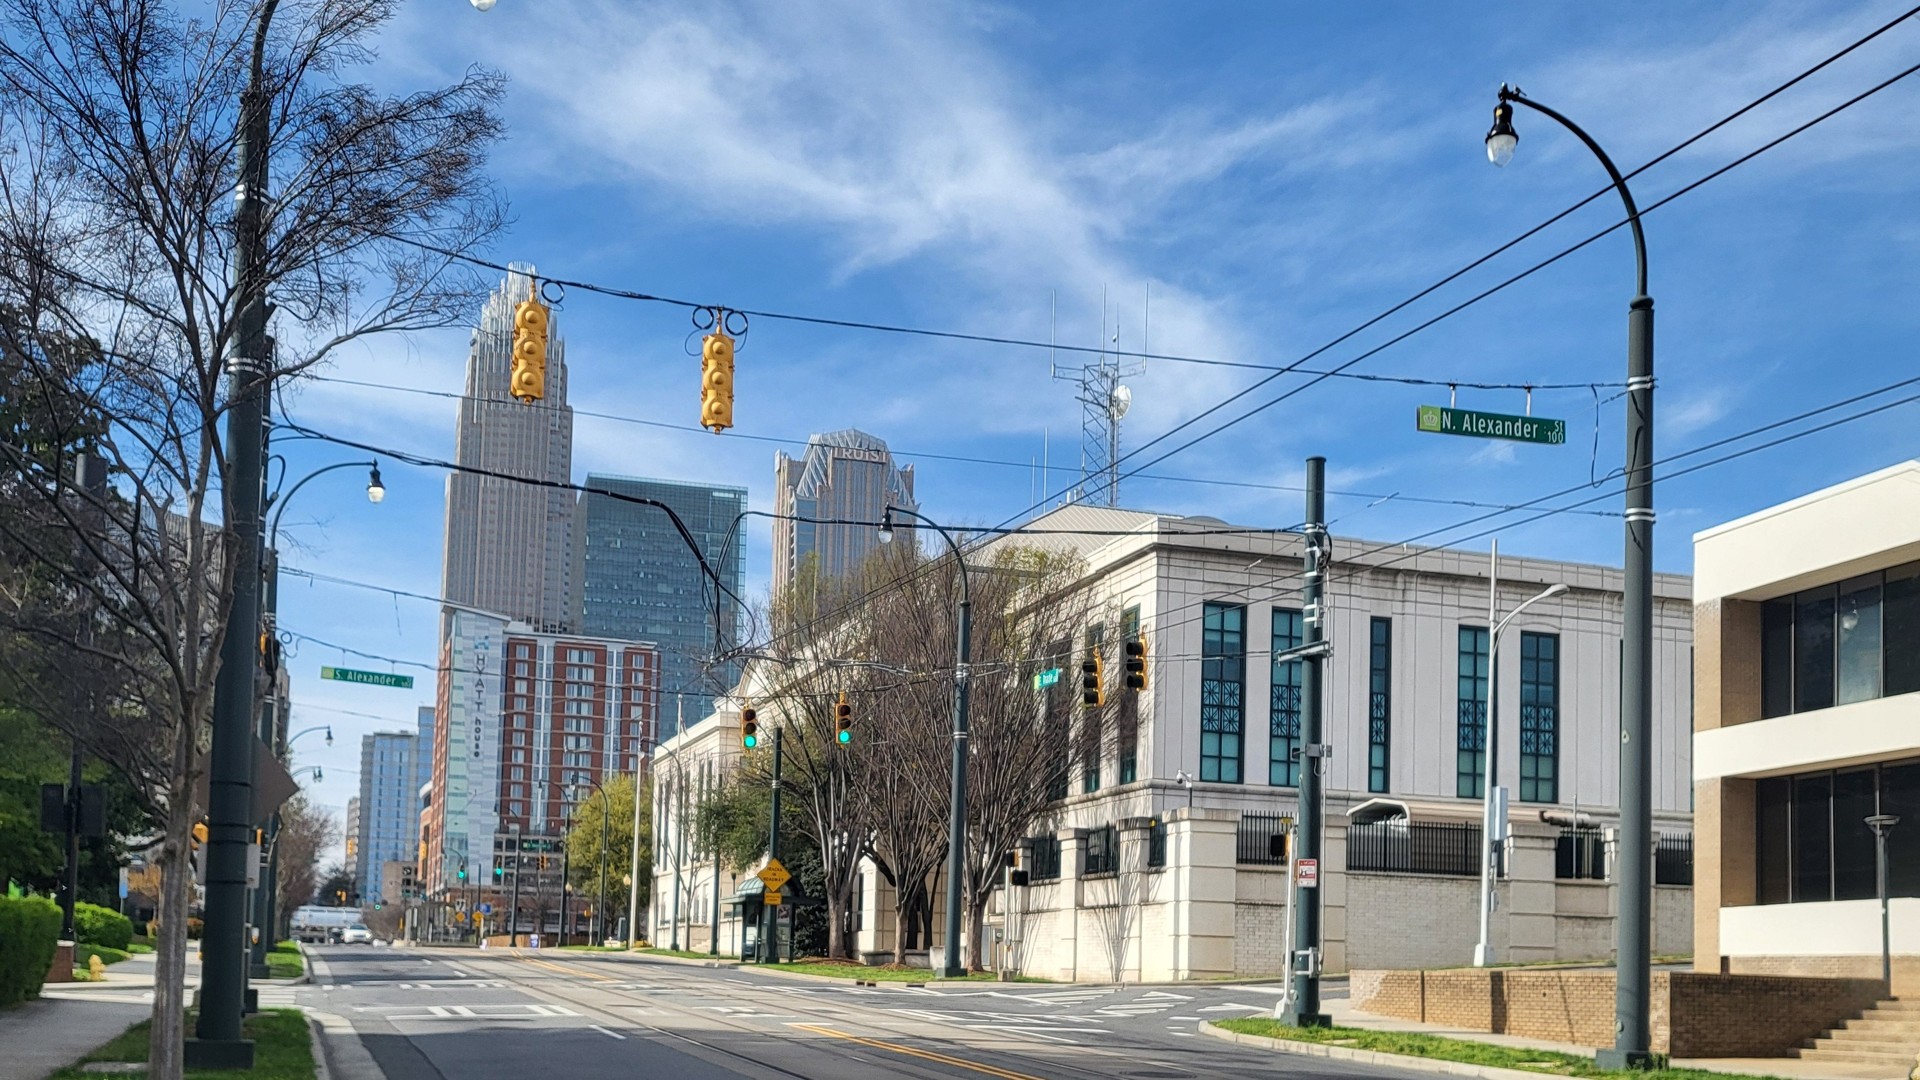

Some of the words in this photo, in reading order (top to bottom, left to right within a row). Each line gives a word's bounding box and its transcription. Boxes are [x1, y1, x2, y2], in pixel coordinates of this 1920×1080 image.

[1442, 411, 1456, 430] N.
[1462, 413, 1539, 439] Alexander
[1554, 420, 1564, 432] St
[1547, 431, 1564, 443] 100
[335, 669, 344, 680] S.
[347, 671, 396, 686] Alexander
[474, 654, 485, 712] HYATT
[473, 716, 482, 758] house
